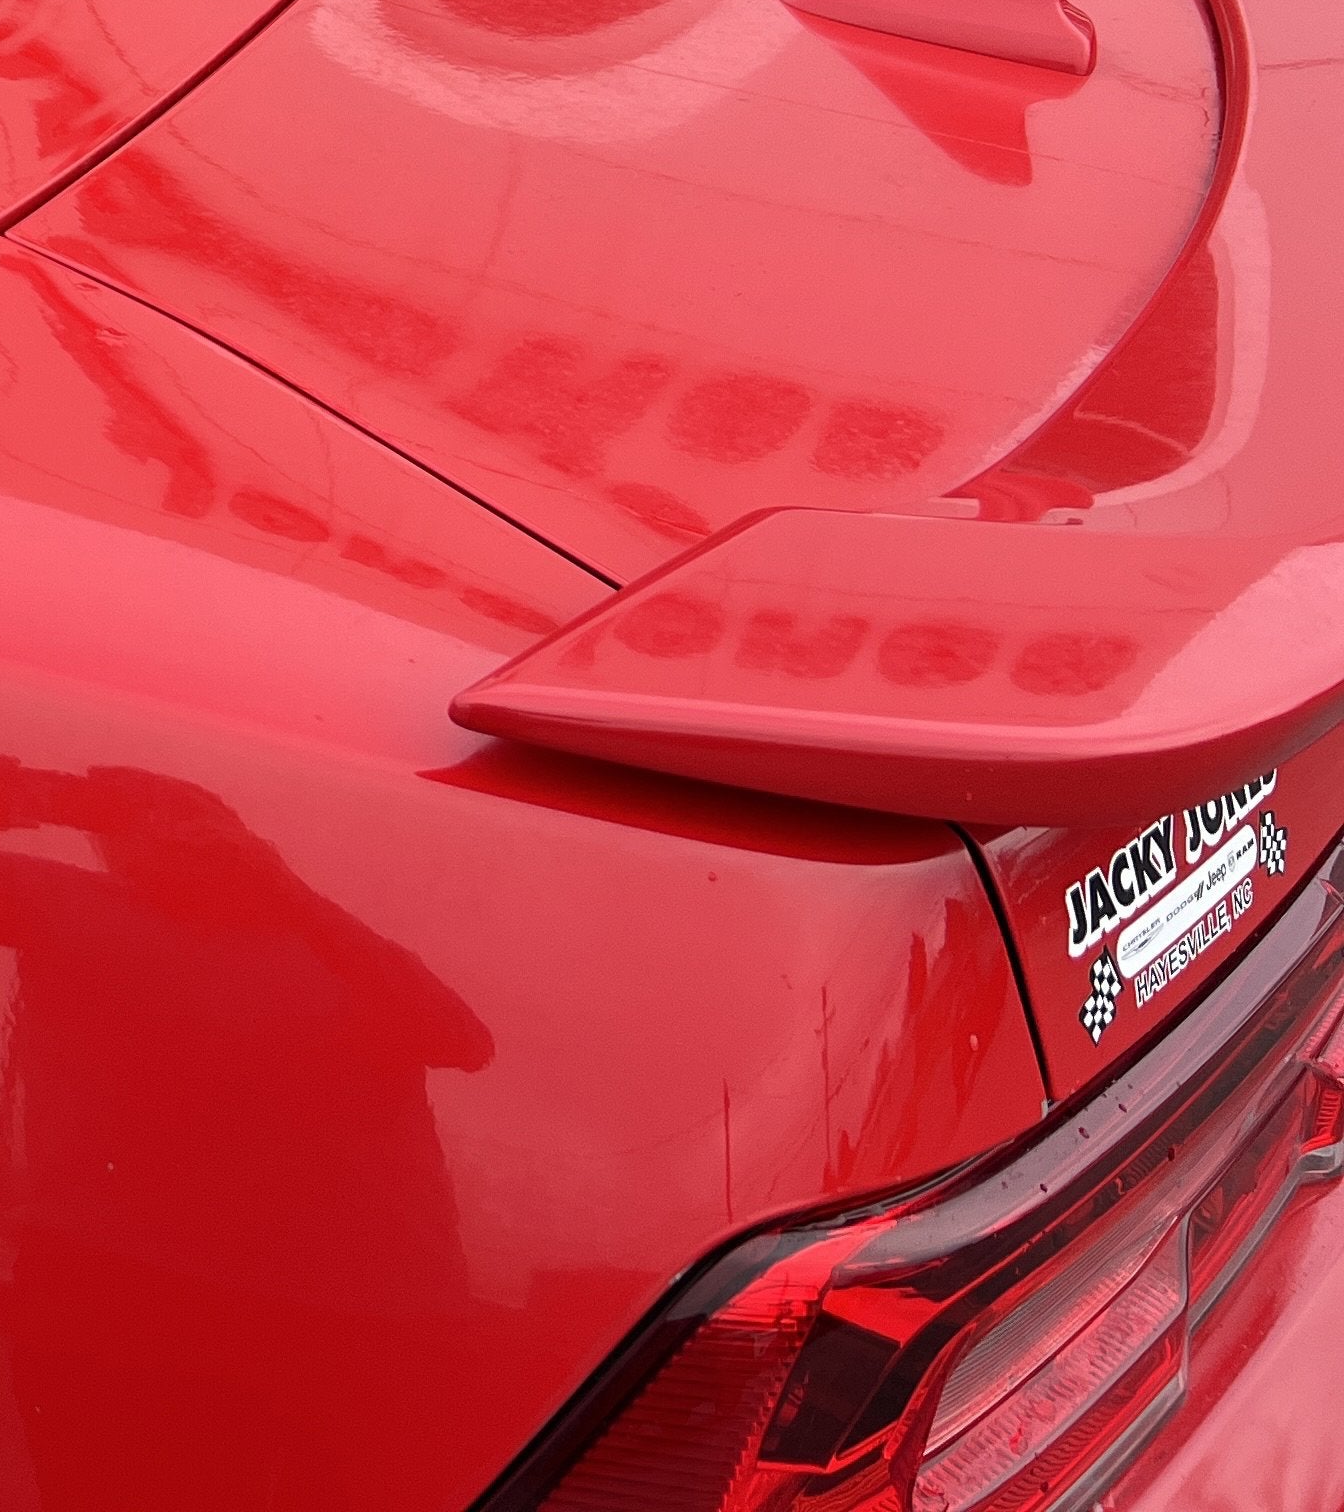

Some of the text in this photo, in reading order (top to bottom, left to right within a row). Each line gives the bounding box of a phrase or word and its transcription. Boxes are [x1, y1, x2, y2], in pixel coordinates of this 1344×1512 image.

[1068, 814, 1174, 946] JACKY
[1205, 863, 1227, 891] Jeep
[1236, 837, 1254, 861] RAM
[1136, 881, 1252, 1004] HAYESVILLE, NC
